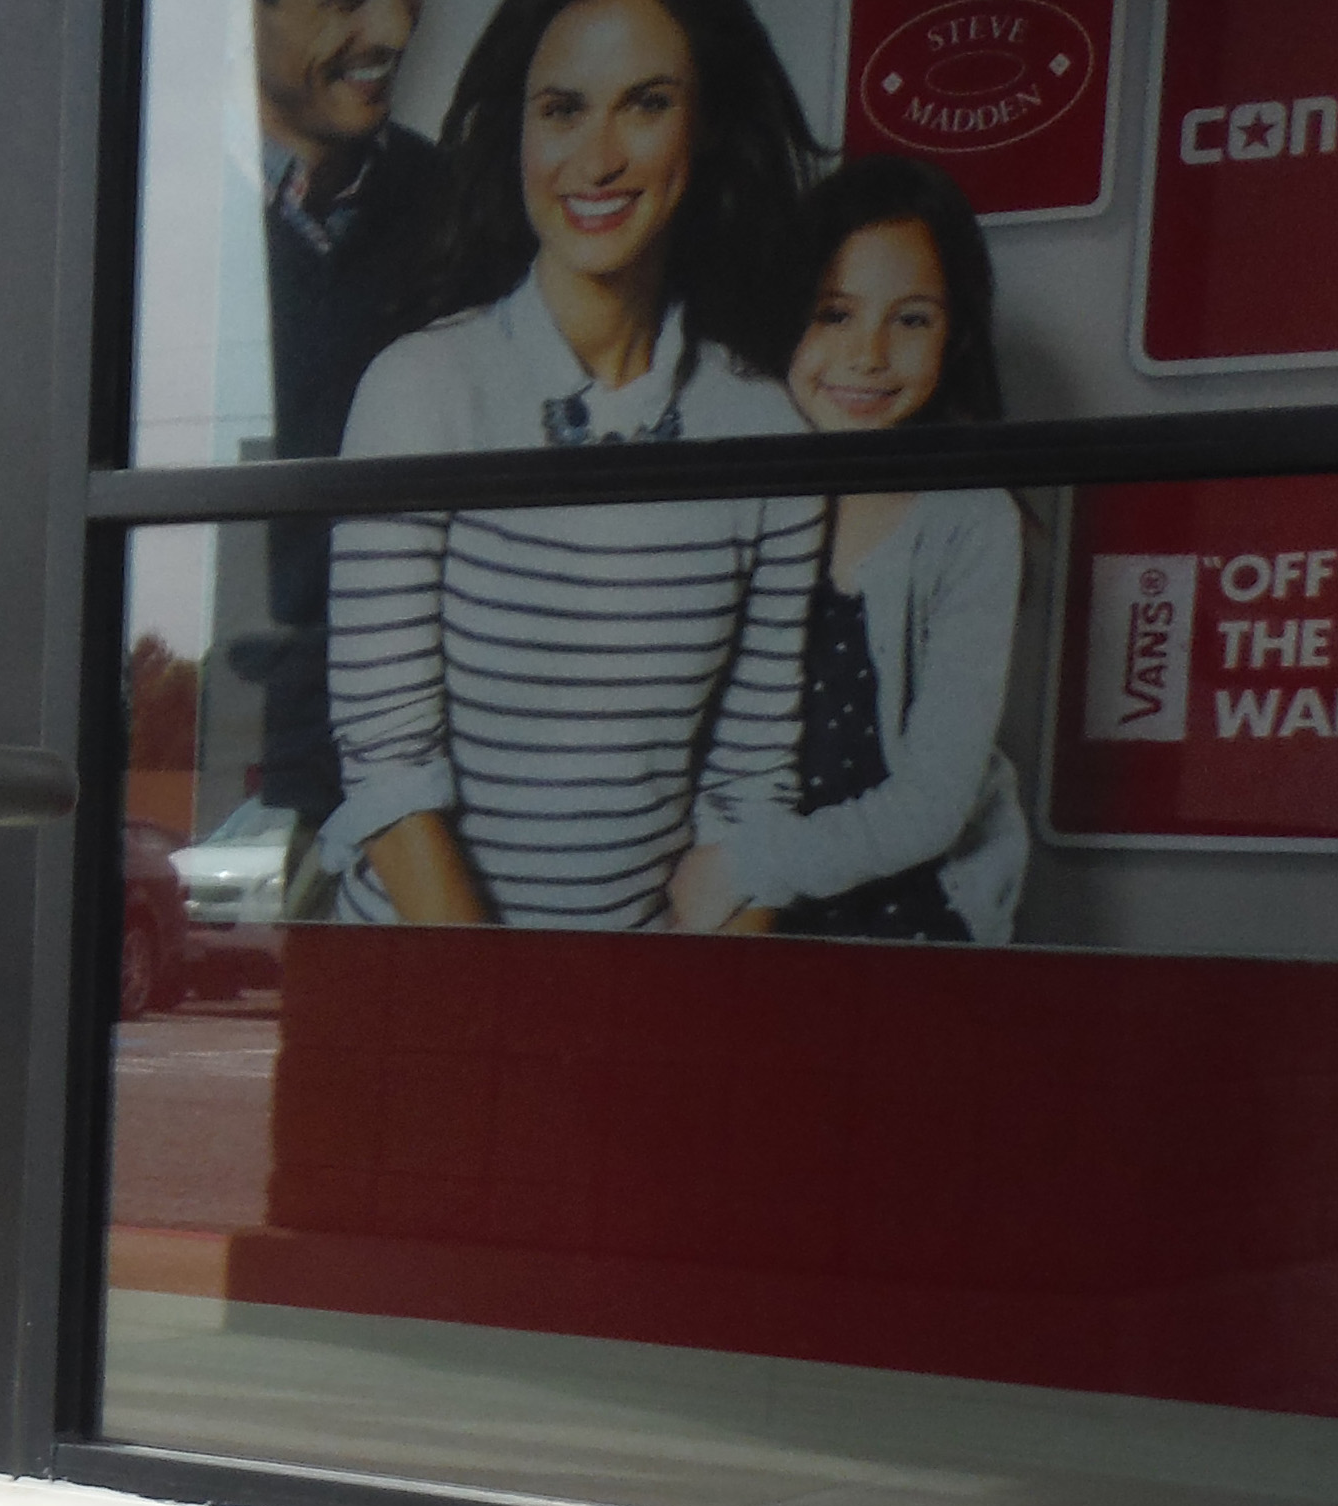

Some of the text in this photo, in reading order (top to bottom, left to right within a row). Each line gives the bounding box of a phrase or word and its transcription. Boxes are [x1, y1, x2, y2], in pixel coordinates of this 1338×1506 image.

[927, 15, 1028, 51] STEVE
[902, 84, 1043, 131] MADDEN
[1217, 619, 1331, 669] THE
[1215, 688, 1338, 738] WA
